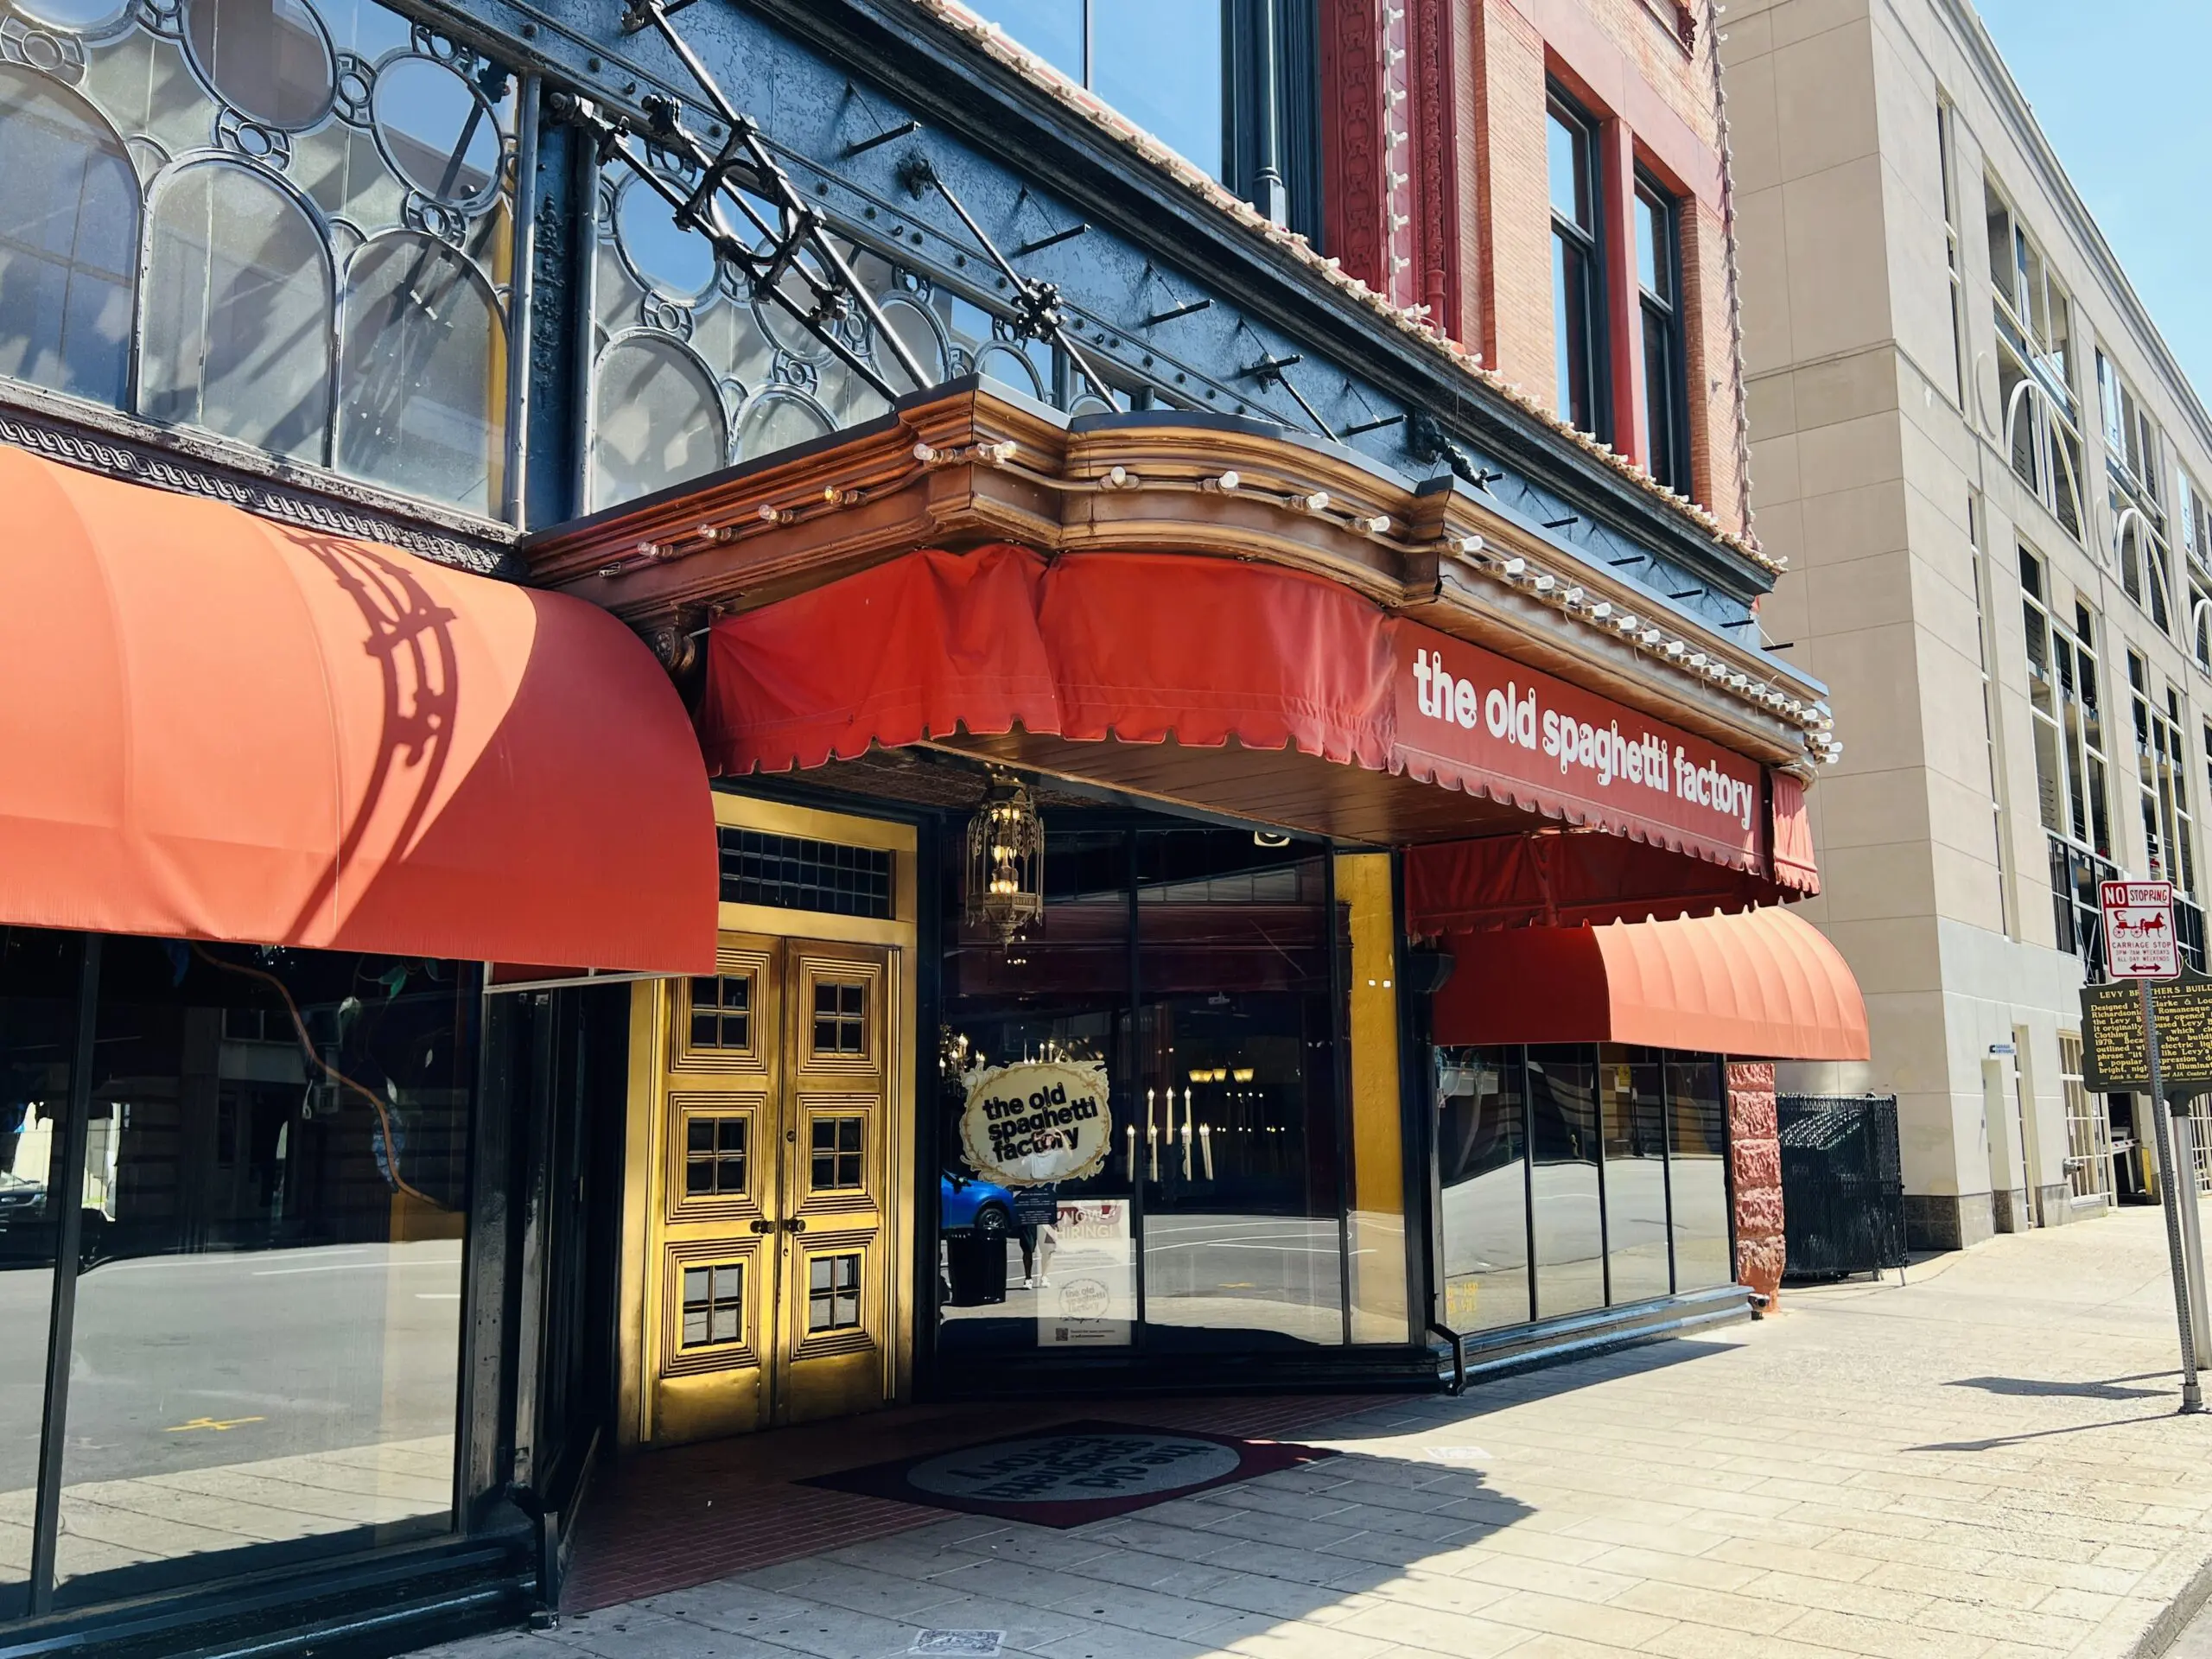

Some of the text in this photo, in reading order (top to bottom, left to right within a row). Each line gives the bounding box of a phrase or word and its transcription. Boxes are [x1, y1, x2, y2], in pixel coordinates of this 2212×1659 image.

[1412, 648, 1753, 830] the old spaghetti factory
[2105, 887, 2167, 905] NO STOPPING
[2100, 990, 2124, 999] LEVY
[2129, 987, 2181, 997] BRTHERS
[2090, 1002, 2128, 1012] Designed
[2092, 1010, 2143, 1019] Richardsoni
[2174, 1012, 2205, 1020] opened
[2102, 1023, 2143, 1032] originally
[2111, 1058, 2143, 1067] popular
[2158, 1056, 2196, 1065] pression
[982, 1082, 1067, 1122] the old
[988, 1096, 1099, 1143] spaghetti
[993, 1127, 1079, 1163] factory
[969, 1440, 1154, 1500] spaghetti
[1067, 1443, 1216, 1490] the old
